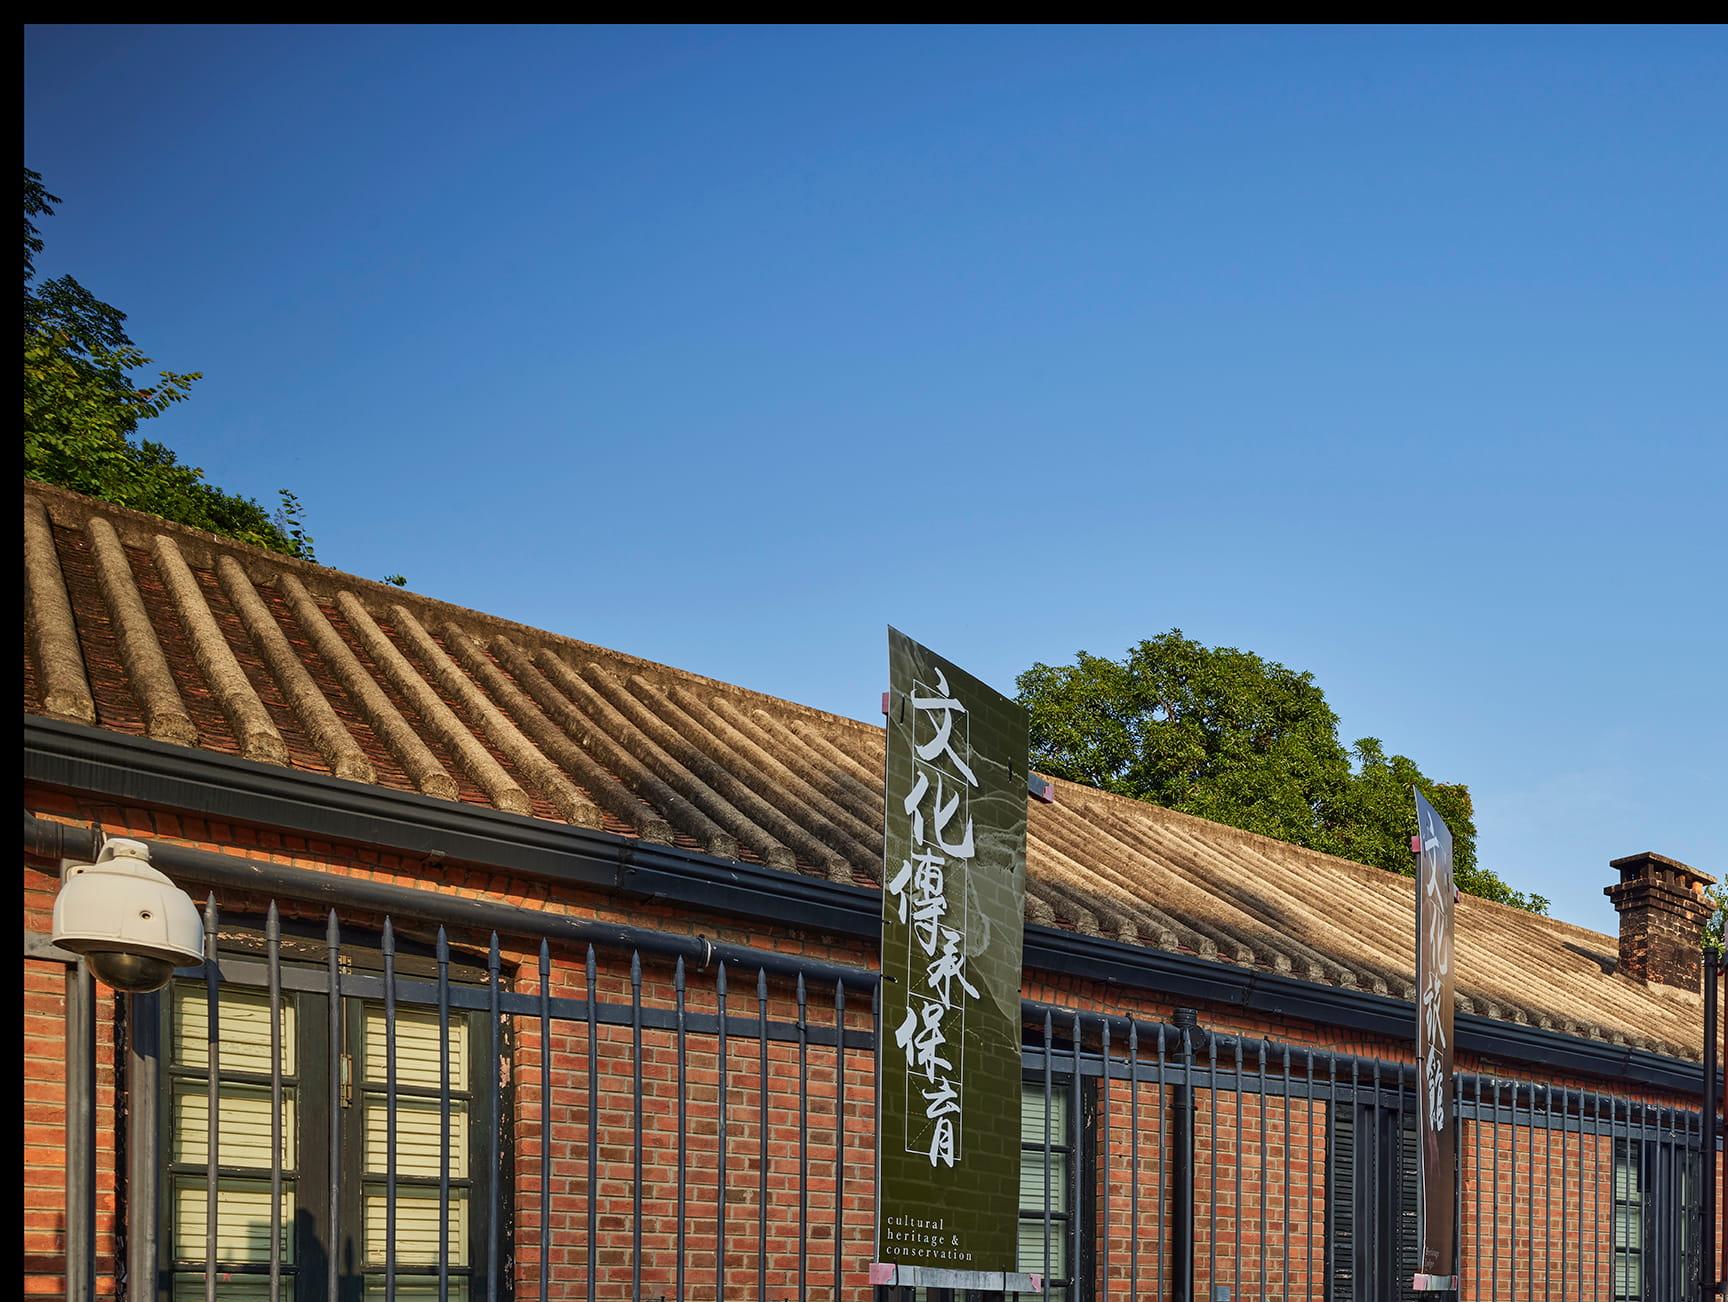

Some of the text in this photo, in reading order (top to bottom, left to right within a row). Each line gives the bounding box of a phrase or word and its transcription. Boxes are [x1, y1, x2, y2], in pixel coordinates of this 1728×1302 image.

[889, 667, 979, 1168] 文化傳承保育
[888, 1215, 943, 1230] cultural
[887, 1228, 959, 1247] heritage &
[886, 1245, 972, 1261] conservation
